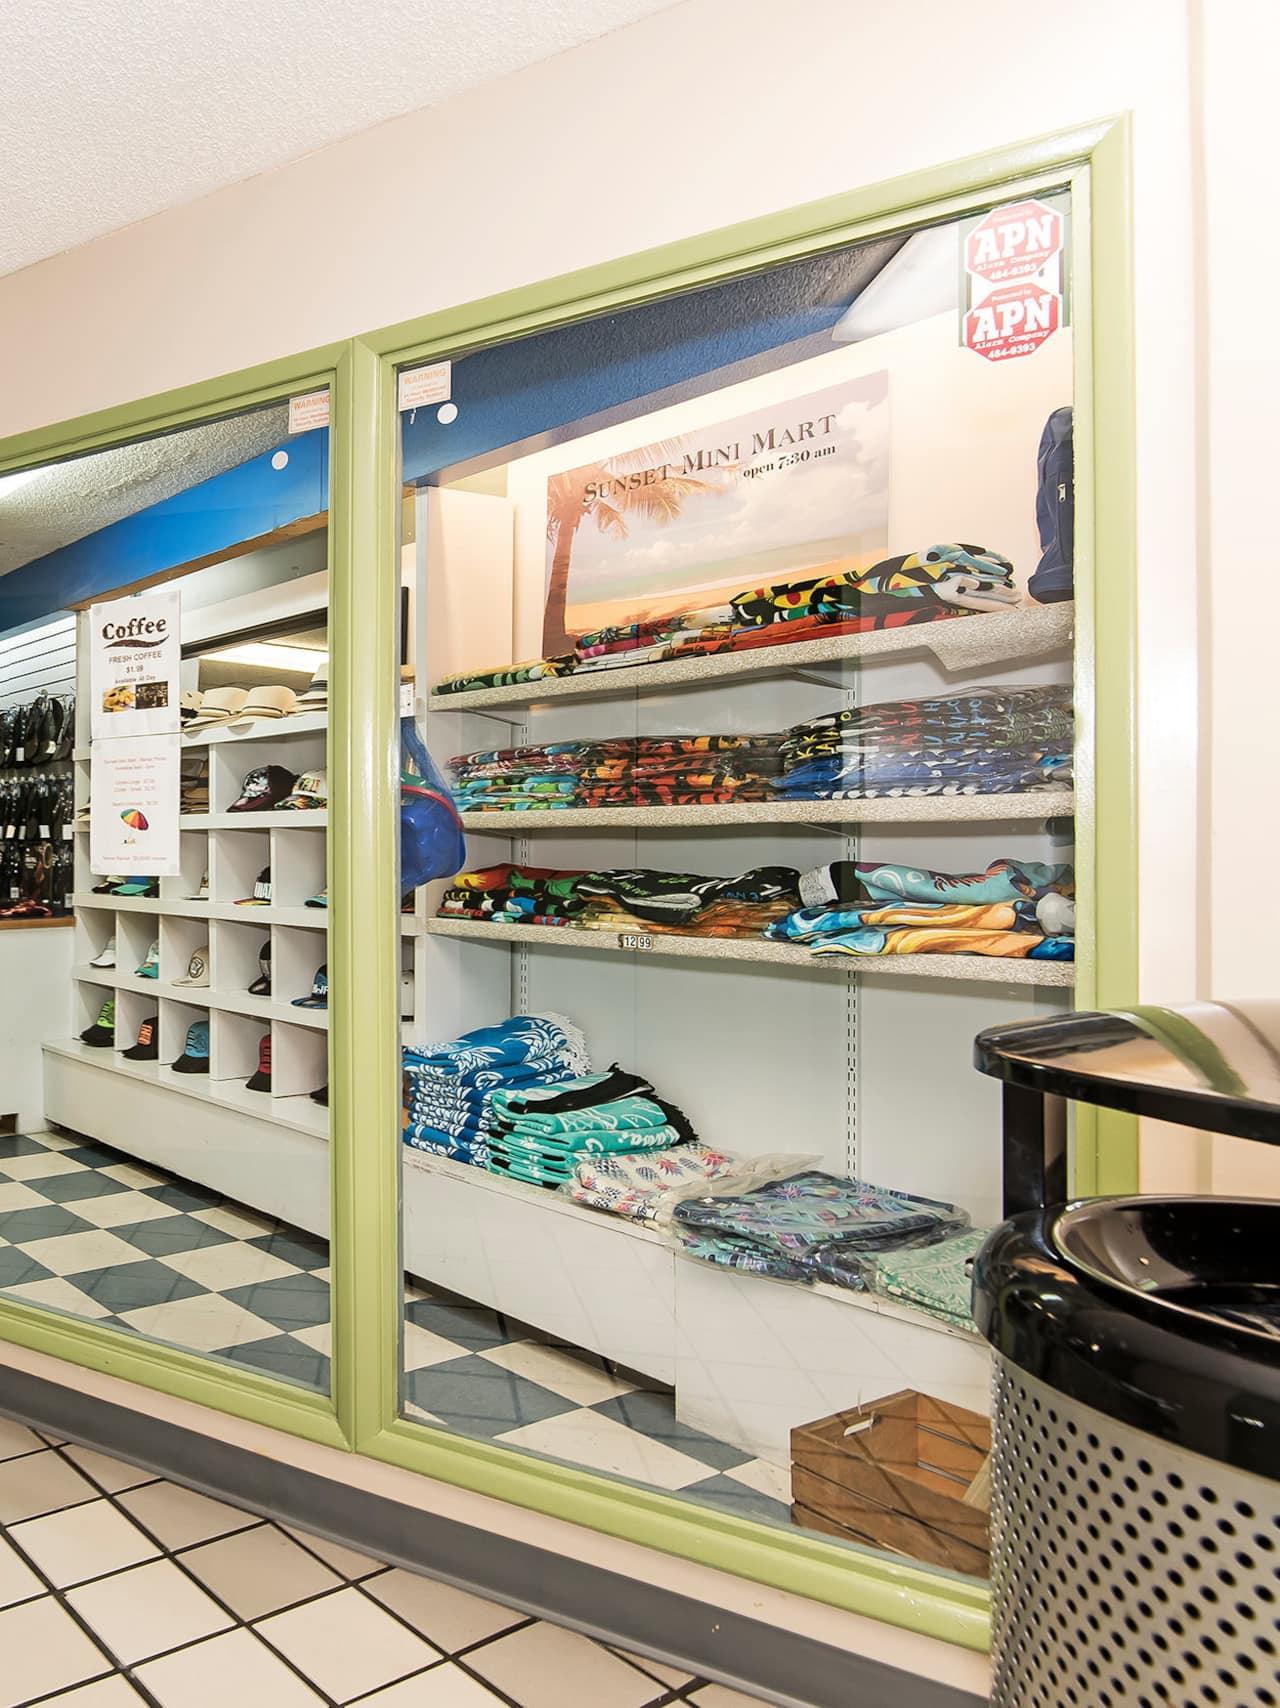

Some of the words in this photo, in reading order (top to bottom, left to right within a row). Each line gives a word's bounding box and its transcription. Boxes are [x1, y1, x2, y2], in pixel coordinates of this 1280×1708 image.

[973, 214, 1054, 265] APN
[972, 294, 1053, 343] APN
[1008, 330, 1050, 343] Company
[582, 464, 672, 504] SUNSET
[682, 442, 740, 475] MINI
[751, 413, 837, 455] MART
[743, 461, 774, 480] open
[777, 449, 811, 471] 7:30
[813, 445, 837, 460] am
[102, 617, 167, 640] Coffee
[108, 655, 132, 664] FRESH
[133, 650, 162, 661] COFFEE
